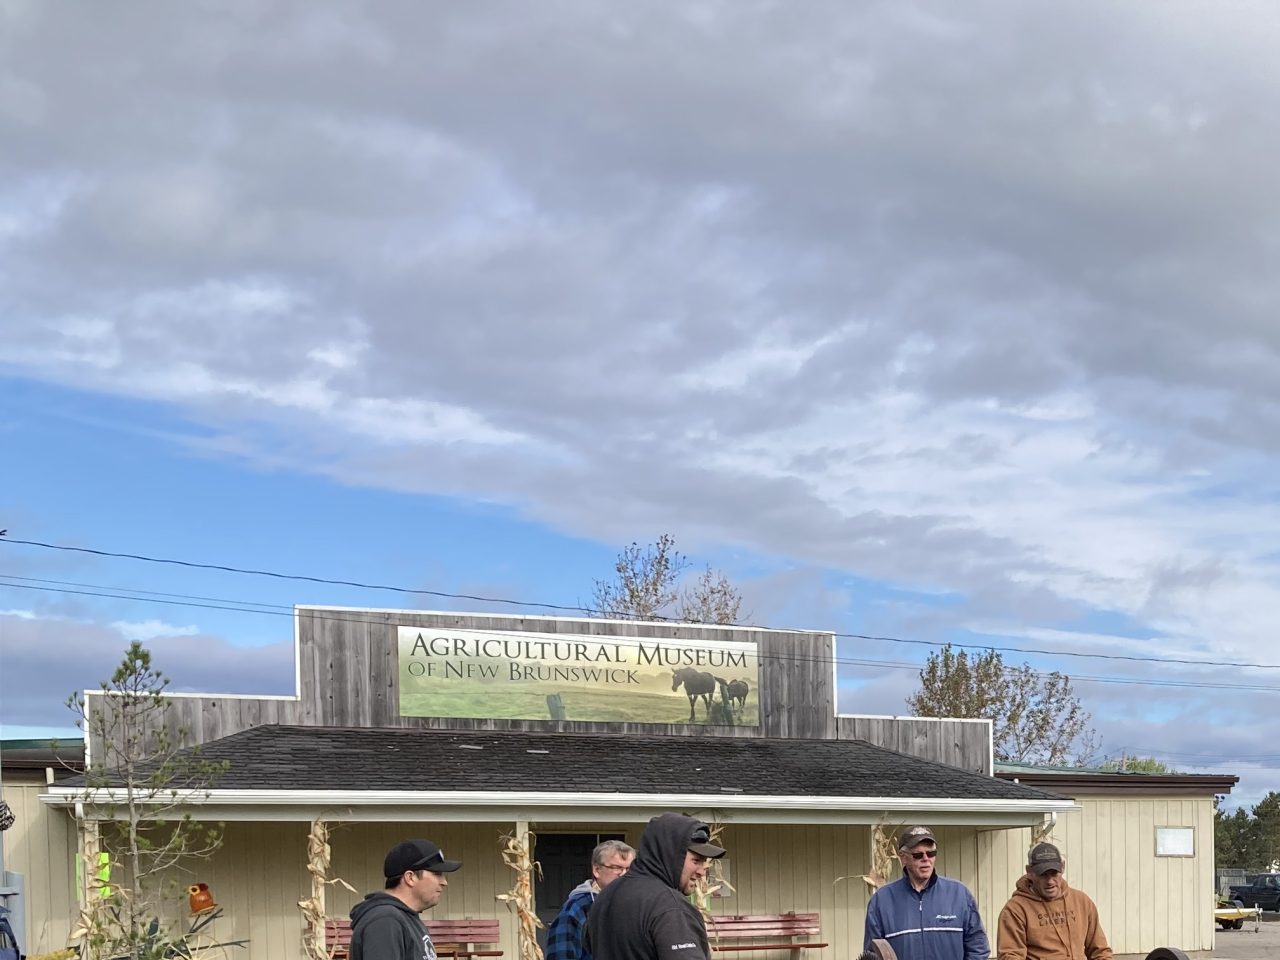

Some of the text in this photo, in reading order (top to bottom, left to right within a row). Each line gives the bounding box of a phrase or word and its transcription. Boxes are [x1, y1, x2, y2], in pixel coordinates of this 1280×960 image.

[410, 632, 748, 668] AGRICULTURAL MUSEUM
[445, 660, 499, 679] NEW
[509, 662, 641, 684] BRUNSWICK
